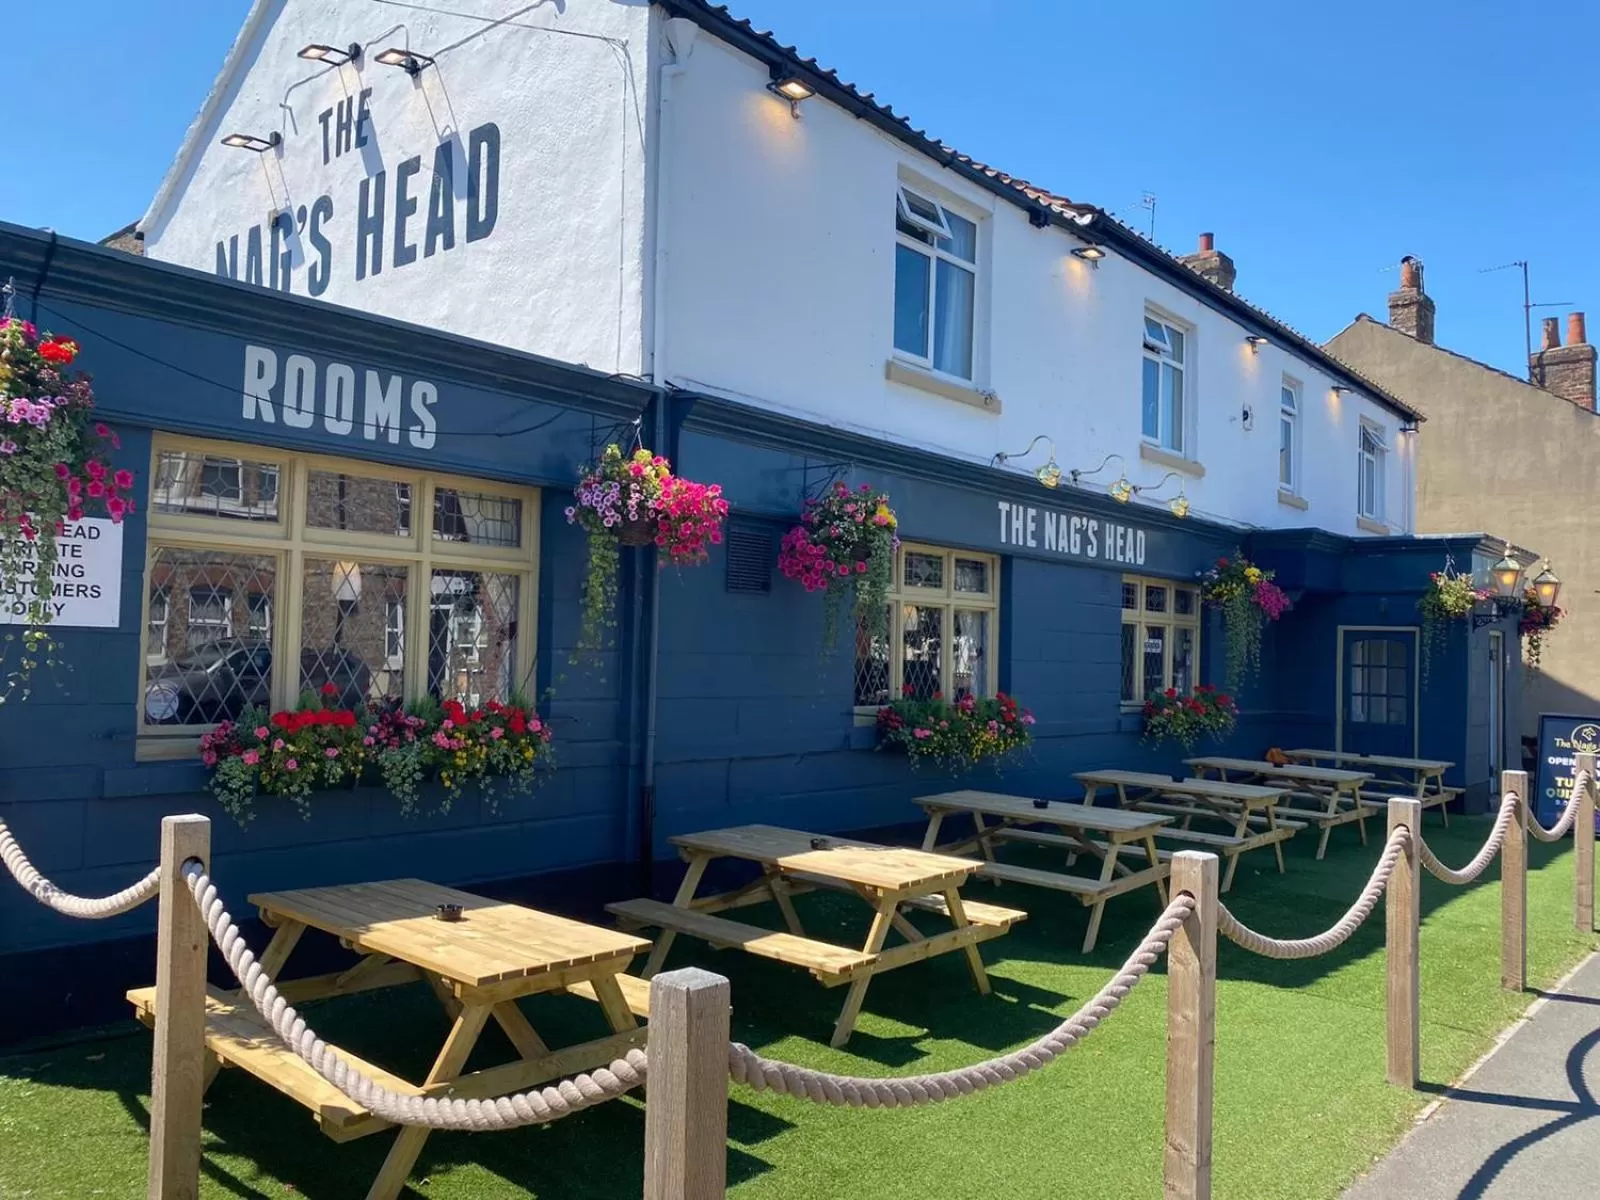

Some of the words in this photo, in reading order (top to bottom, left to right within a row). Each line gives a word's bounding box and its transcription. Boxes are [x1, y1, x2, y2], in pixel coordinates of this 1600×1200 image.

[318, 87, 373, 166] THE
[215, 194, 334, 297] NAG'S
[355, 121, 501, 282] HEAD
[242, 344, 438, 450] ROOMS
[58, 523, 101, 540] EAD
[998, 501, 1037, 548] THE
[1044, 511, 1099, 558] NAG'S
[1105, 523, 1146, 565] HEAD
[1554, 738, 1571, 748] The
